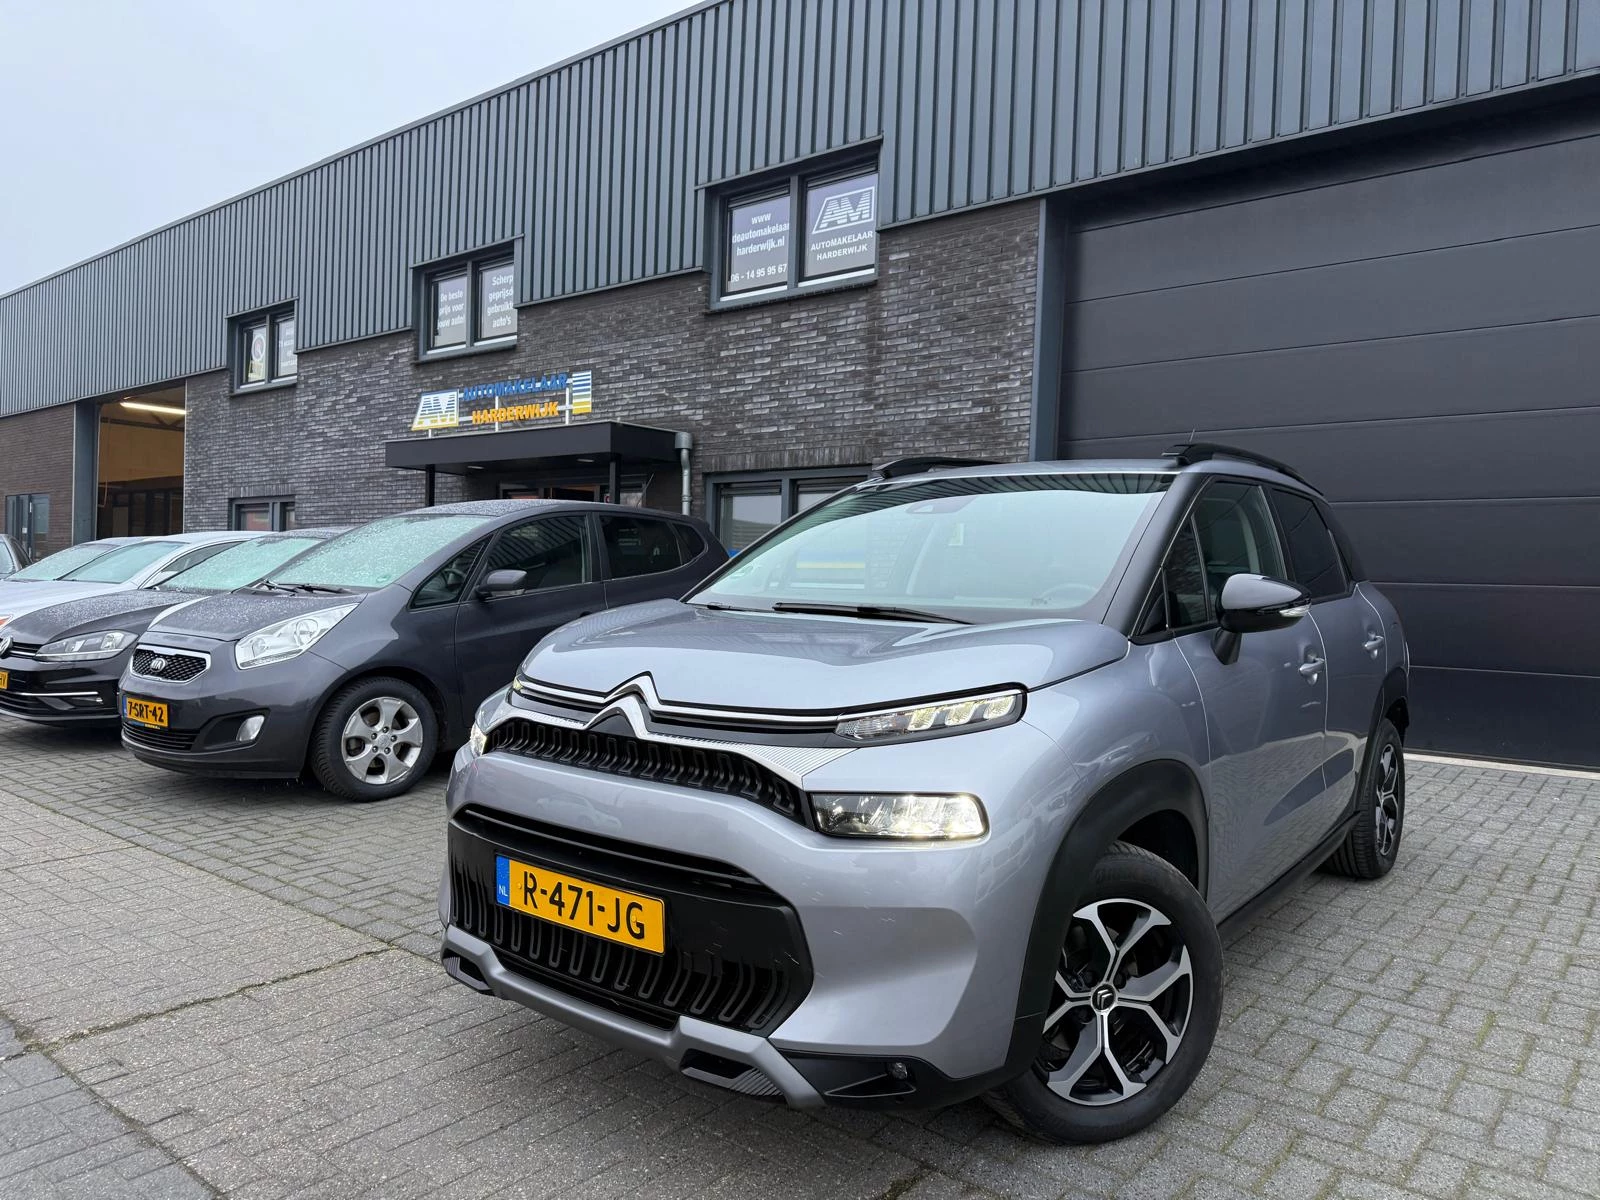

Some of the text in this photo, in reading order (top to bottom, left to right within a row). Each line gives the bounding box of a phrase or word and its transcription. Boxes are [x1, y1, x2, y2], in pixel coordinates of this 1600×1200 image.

[751, 213, 771, 225] www
[736, 235, 785, 256] harderwijk.nl
[810, 230, 873, 251] AUTOMAKELAAR
[816, 244, 868, 261] HARDERWIJK
[746, 269, 755, 279] 14
[756, 267, 766, 278] 95
[767, 265, 776, 276] 95
[778, 263, 788, 274] 67
[462, 373, 568, 401] AUTOMAKELAAR
[471, 401, 559, 424] HARDERWIJK
[127, 700, 165, 723] 7-SRT-42
[498, 884, 508, 897] NL
[523, 870, 645, 940] R-471-JG
